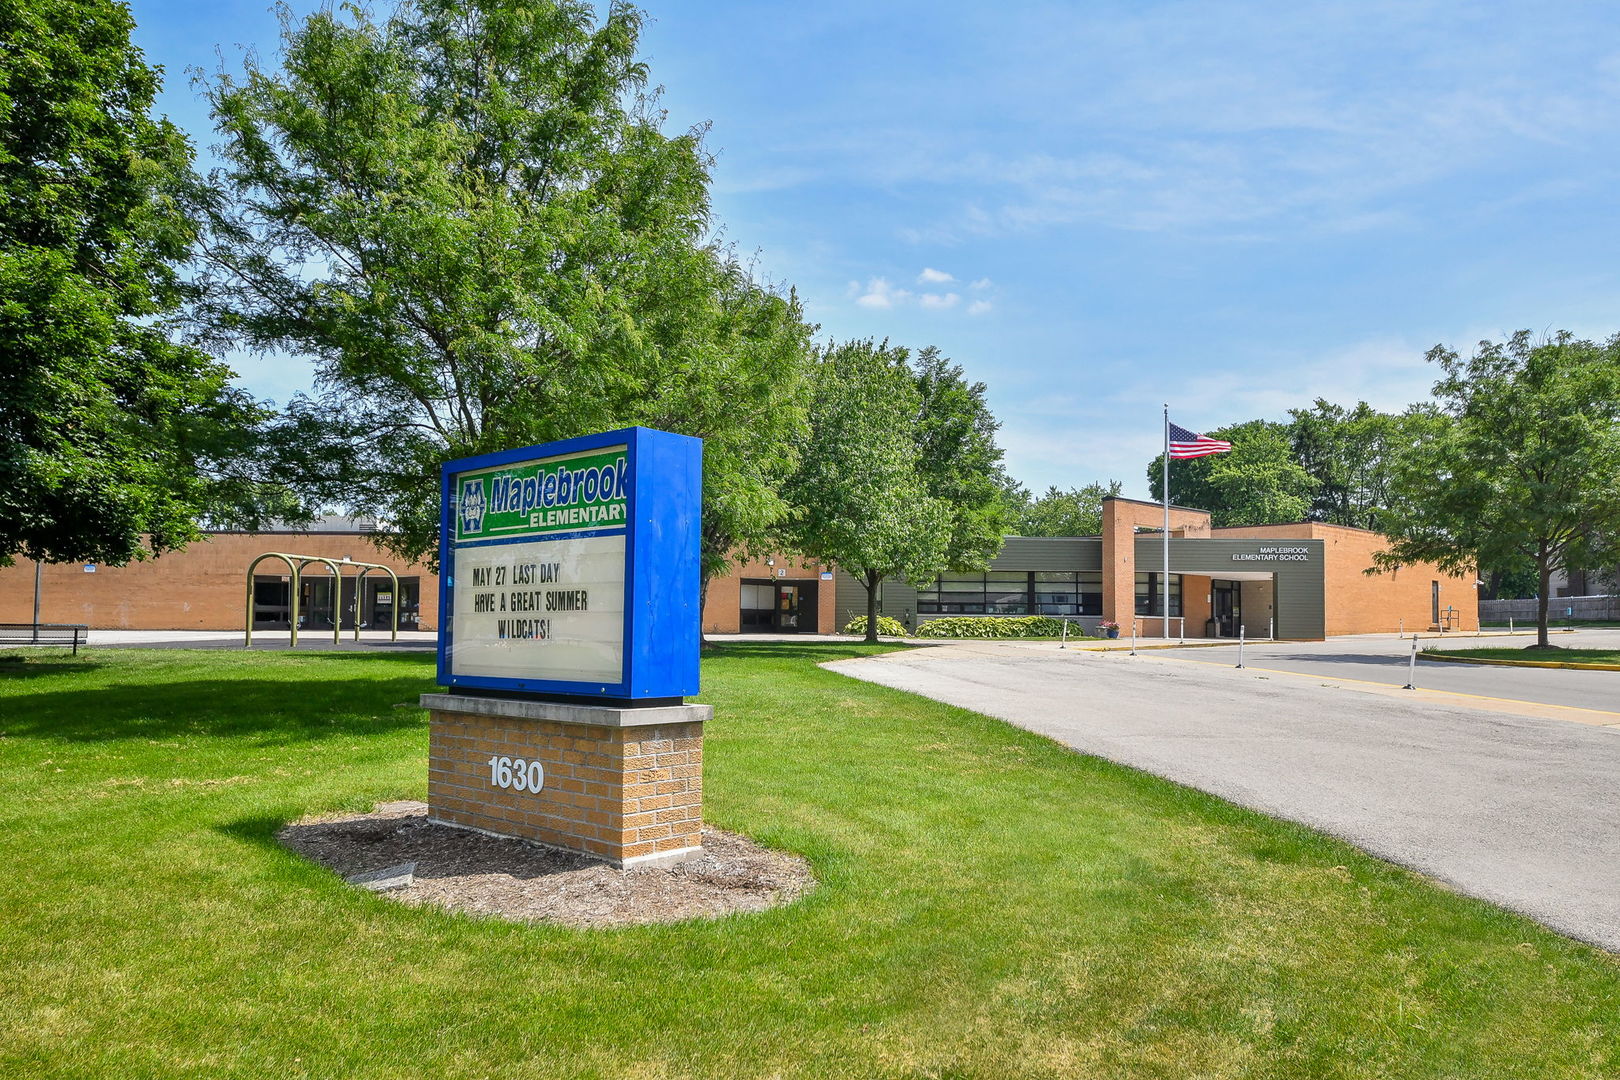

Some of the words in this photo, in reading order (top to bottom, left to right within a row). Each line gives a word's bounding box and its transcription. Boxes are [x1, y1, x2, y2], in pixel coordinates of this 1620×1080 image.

[490, 457, 627, 517] Maplebrook
[473, 568, 491, 586] MAY
[496, 567, 506, 585] 27
[513, 564, 536, 584] LAST
[541, 563, 560, 583] DAY
[475, 594, 494, 612] HAVE
[500, 593, 506, 611] A
[511, 591, 541, 611] GREAT
[546, 590, 587, 611] SUMMER
[497, 619, 550, 639] WILDCATS!
[488, 756, 544, 794] 1630
